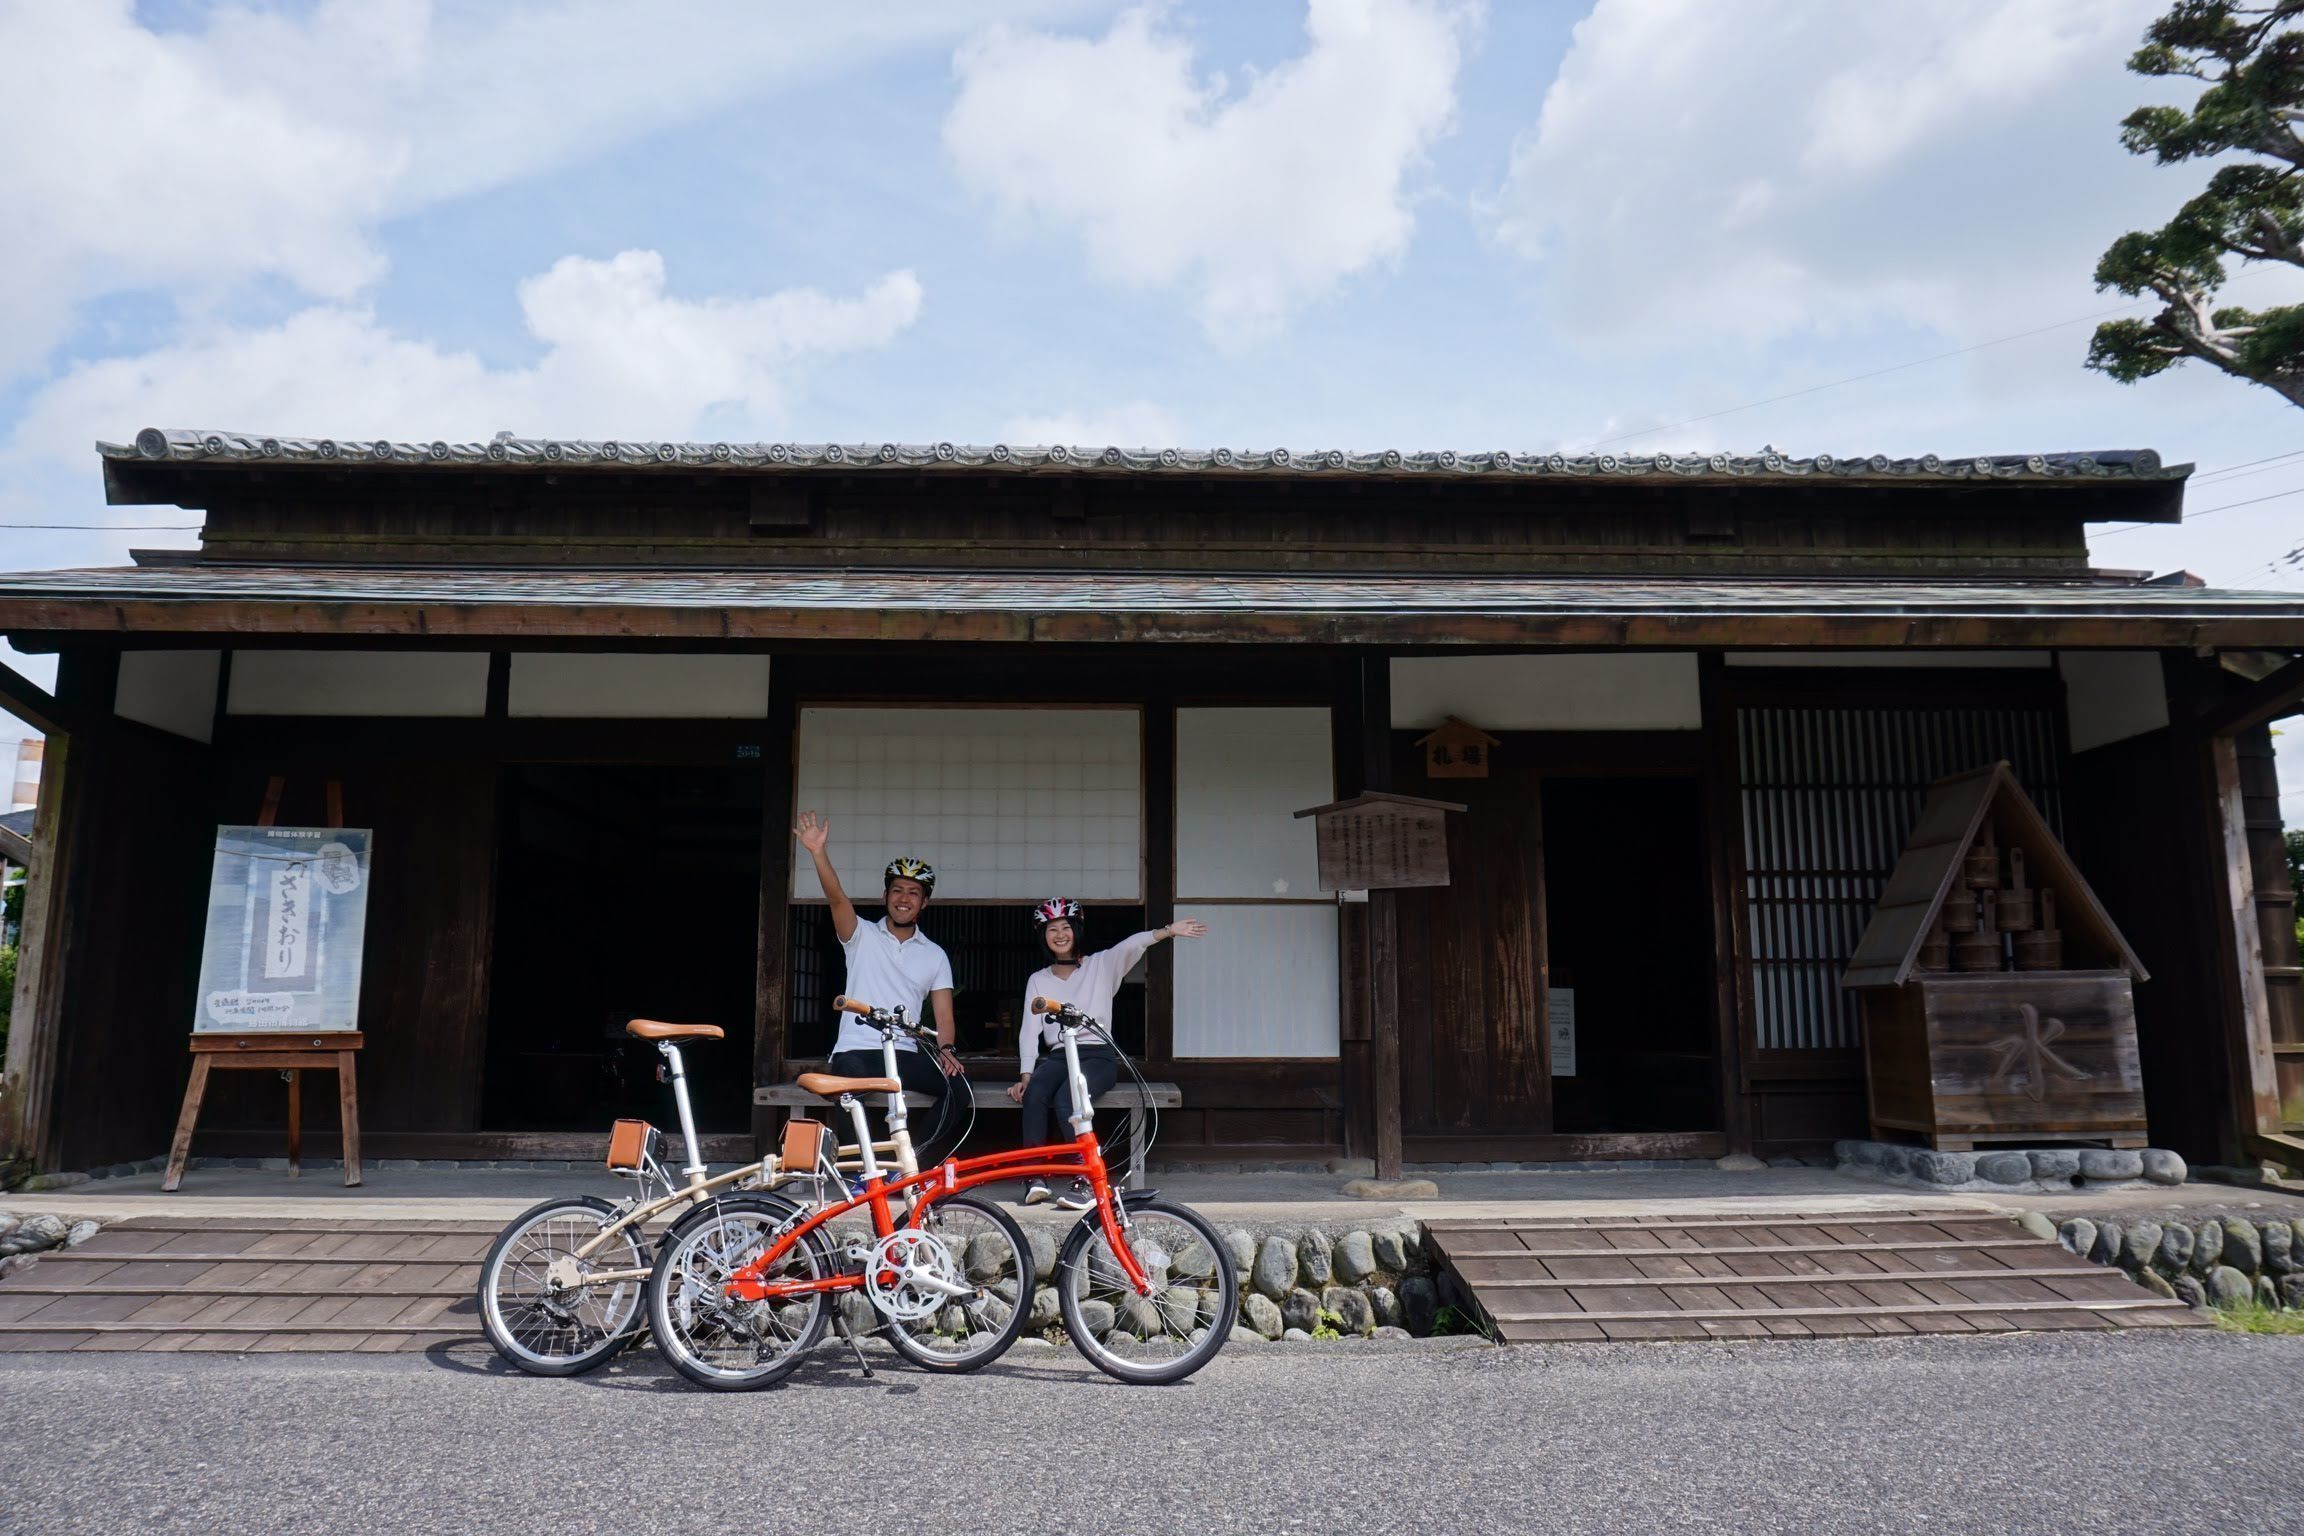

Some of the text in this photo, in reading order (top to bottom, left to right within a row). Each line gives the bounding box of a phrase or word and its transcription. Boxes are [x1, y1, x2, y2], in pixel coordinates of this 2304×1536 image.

[278, 874, 300, 972] さきおり
[1987, 1003, 2093, 1102] 水
